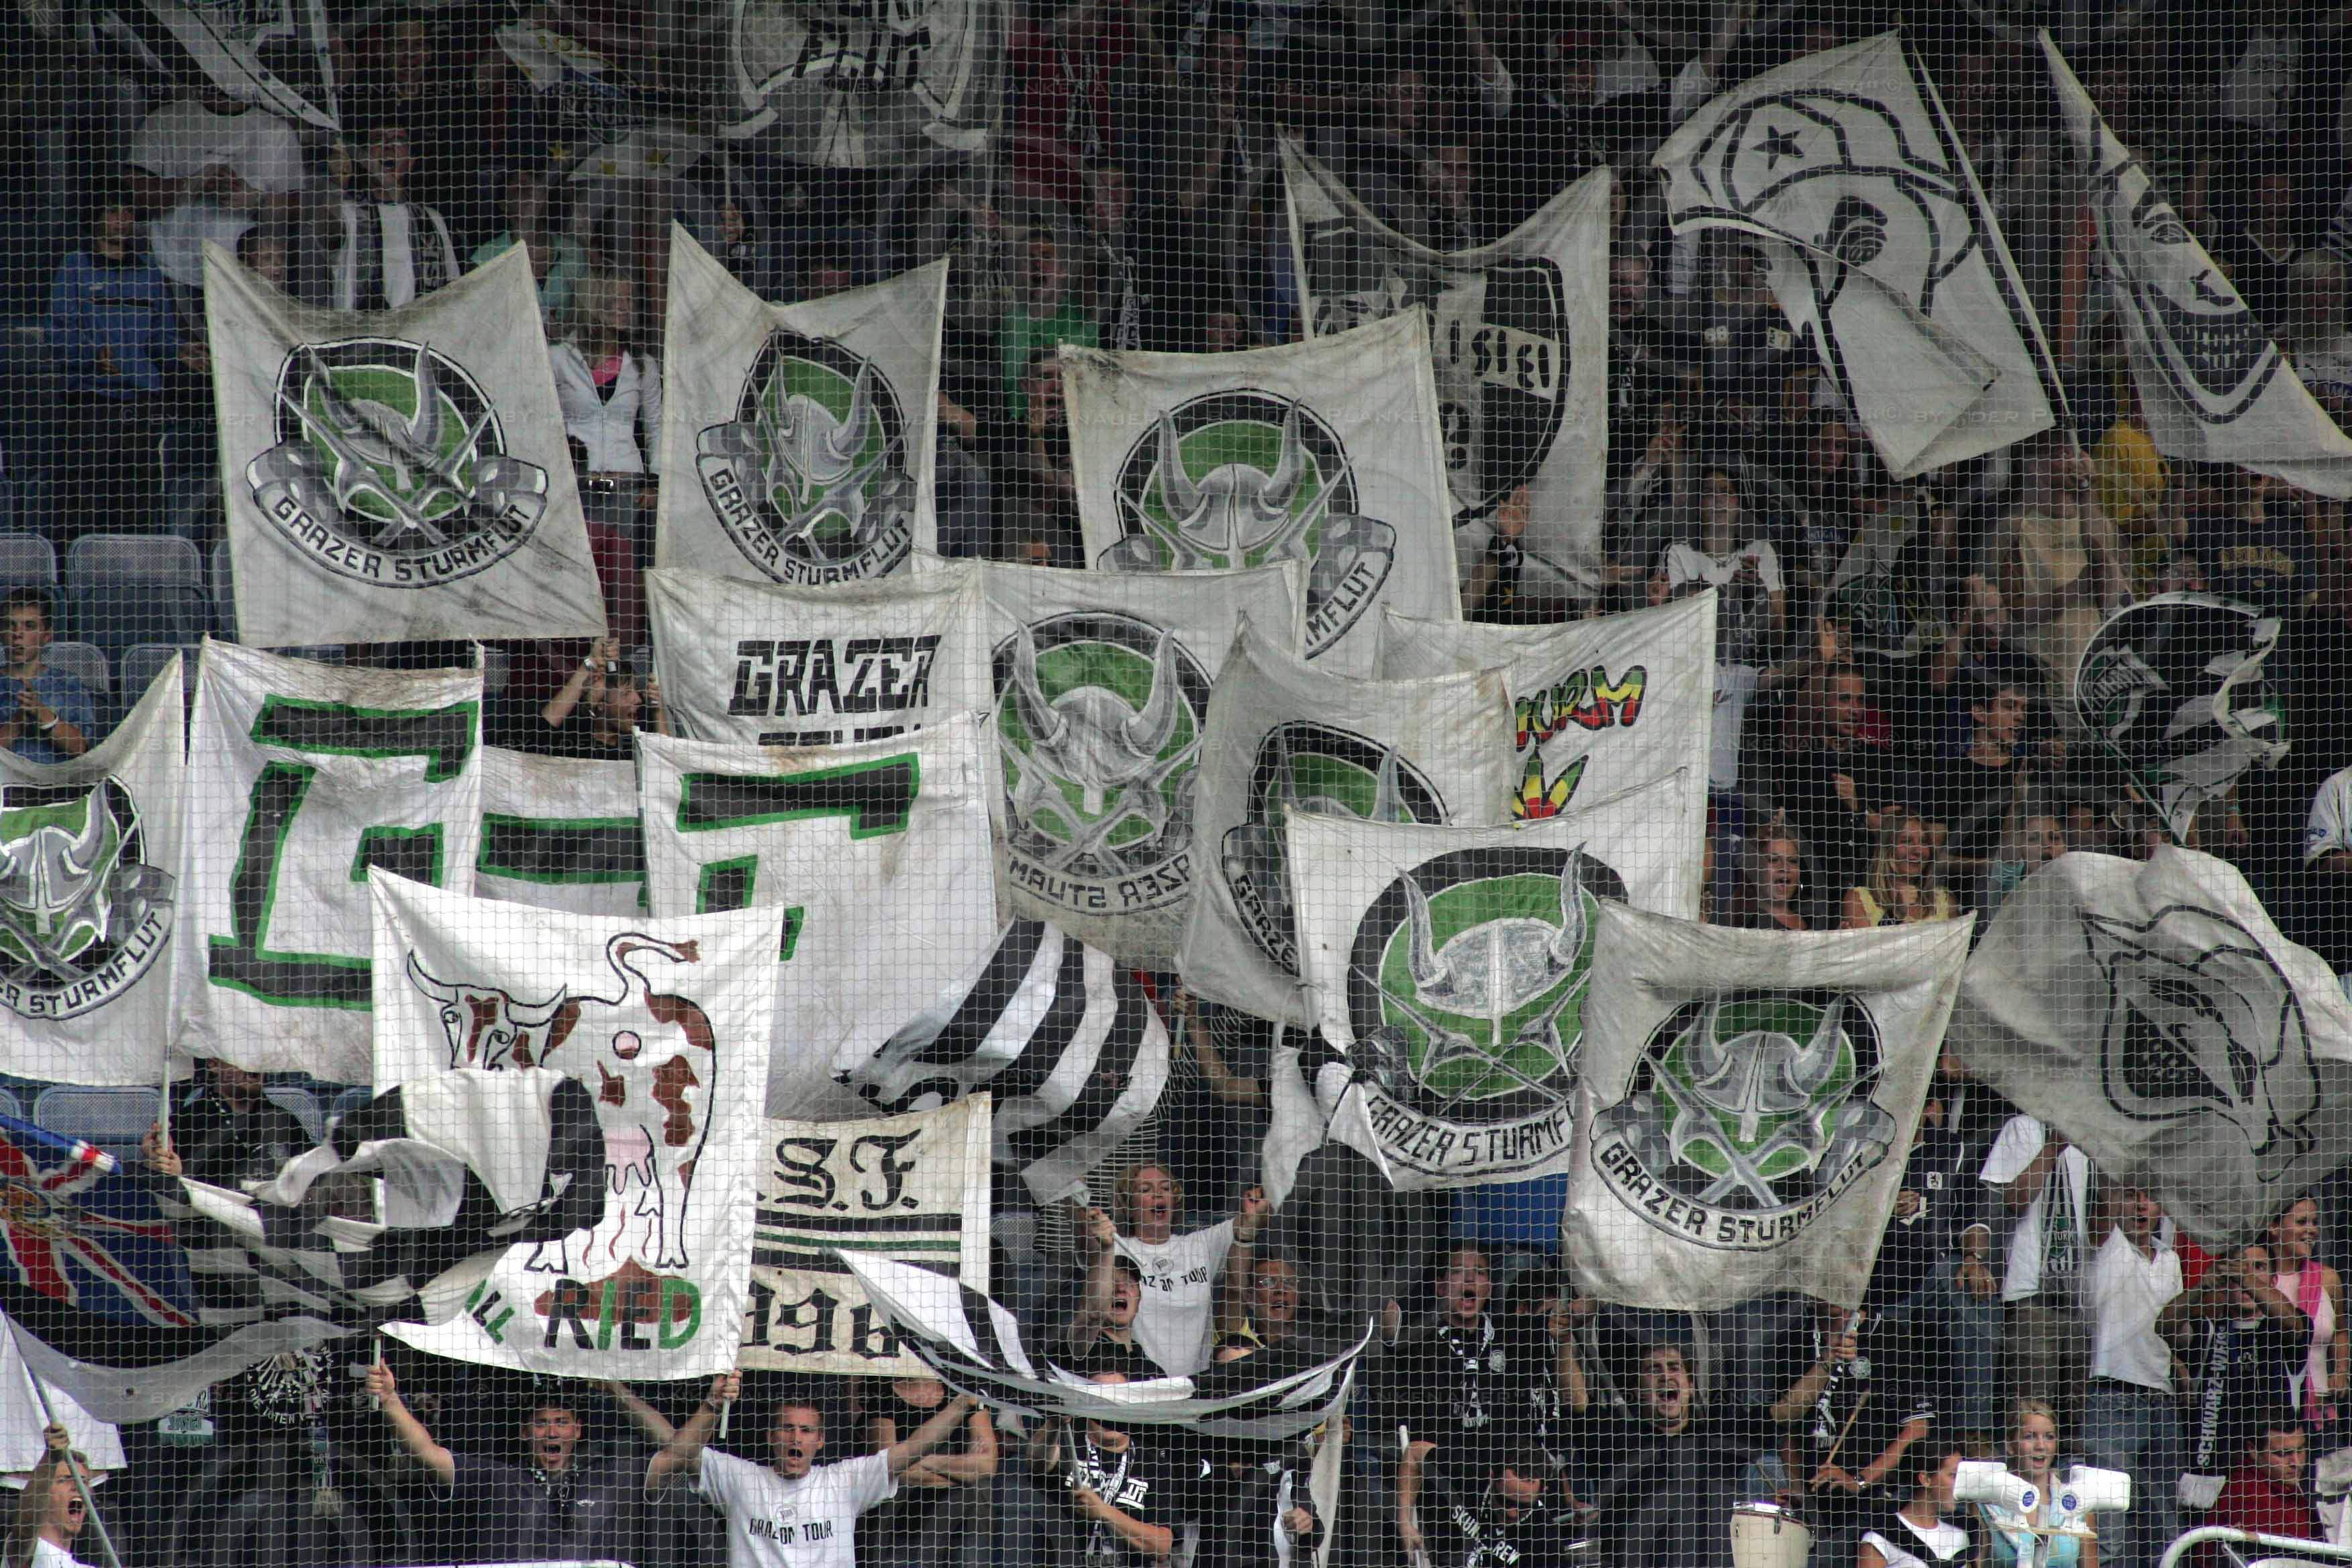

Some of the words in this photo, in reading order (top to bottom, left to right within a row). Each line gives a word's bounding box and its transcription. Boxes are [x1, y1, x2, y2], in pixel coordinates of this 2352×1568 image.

[273, 496, 381, 579] GRAZER
[394, 504, 530, 581] STURMFLUT
[709, 468, 779, 567] GRAZER
[784, 515, 912, 585] STURMFLUT
[1306, 562, 1375, 646] MFLUT
[728, 635, 941, 716] GRAZER
[30, 912, 162, 1014] STURMFLUT
[1234, 873, 1300, 977] GRAZE
[1367, 1095, 1455, 1166] GRAZER
[1600, 1141, 1708, 1235] GRAZER
[1717, 1151, 1865, 1243] STURMFLUT
[802, 1520, 833, 1542] TOUR
[1493, 1541, 1520, 1565] REW
